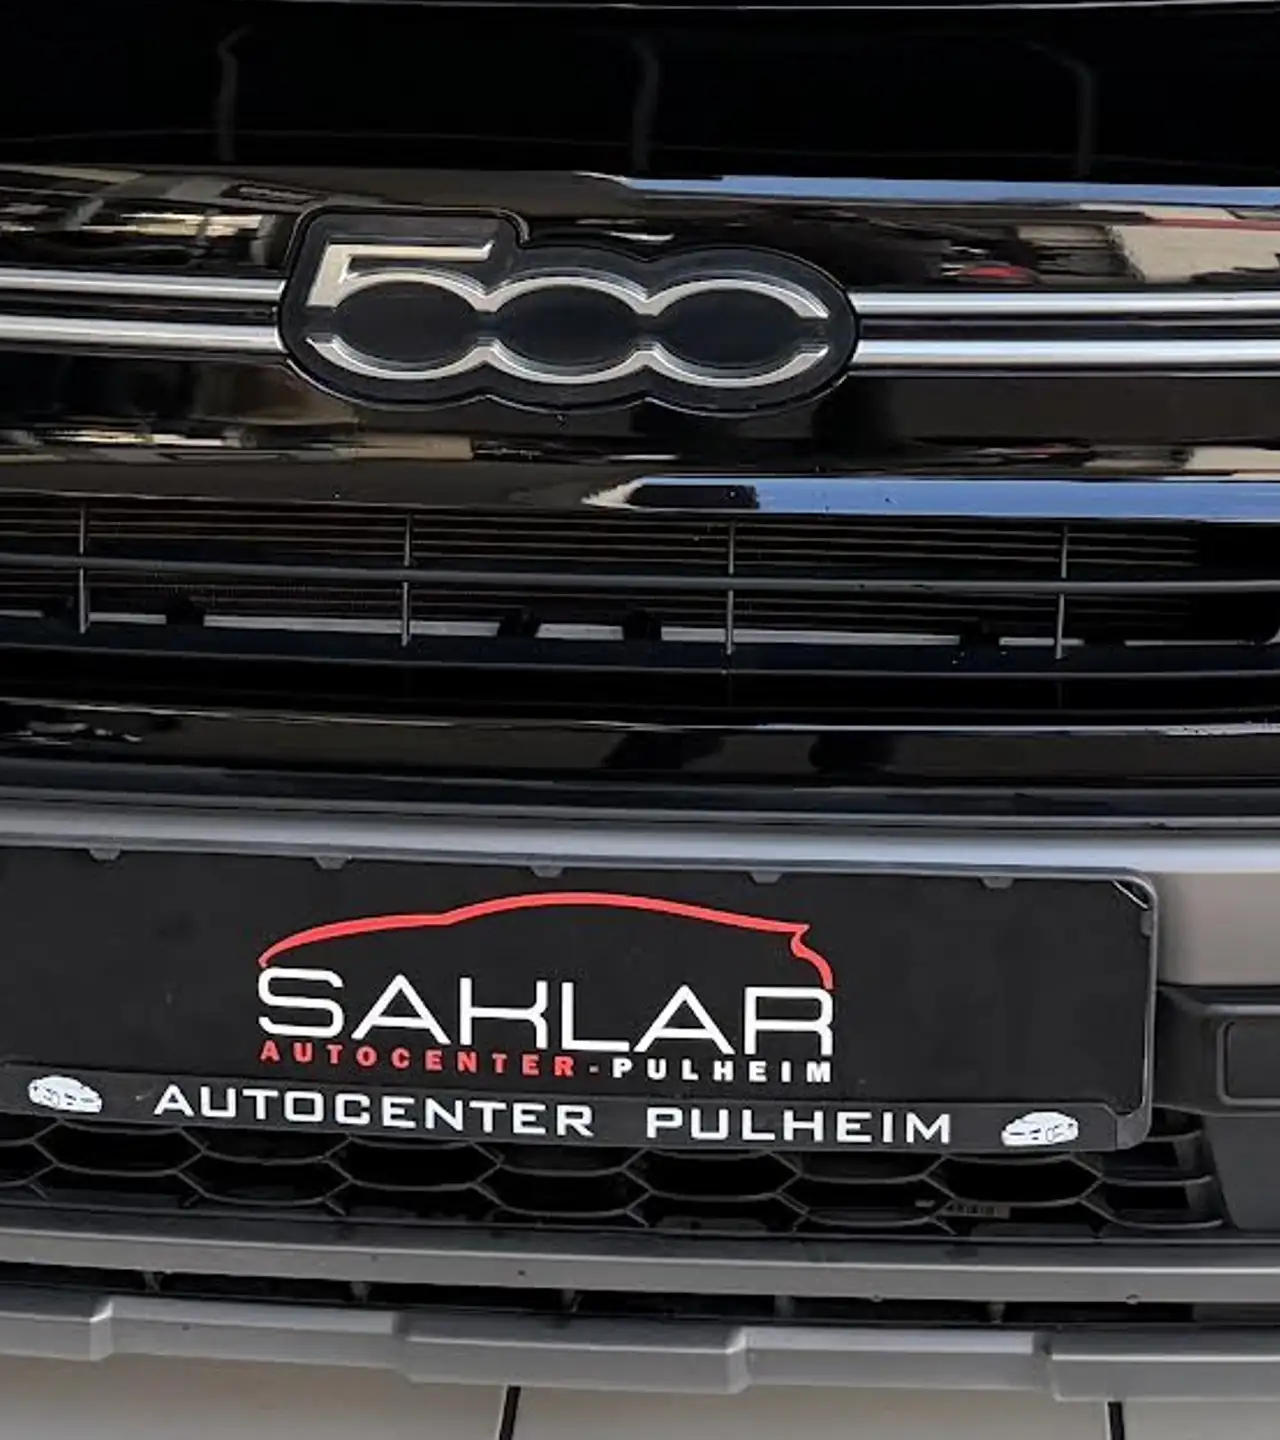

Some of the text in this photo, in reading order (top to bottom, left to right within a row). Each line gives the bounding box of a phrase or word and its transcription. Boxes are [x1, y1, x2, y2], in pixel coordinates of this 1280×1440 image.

[306, 242, 830, 388] 500
[153, 1084, 953, 1145] AUTOCENTER PULHEIM
